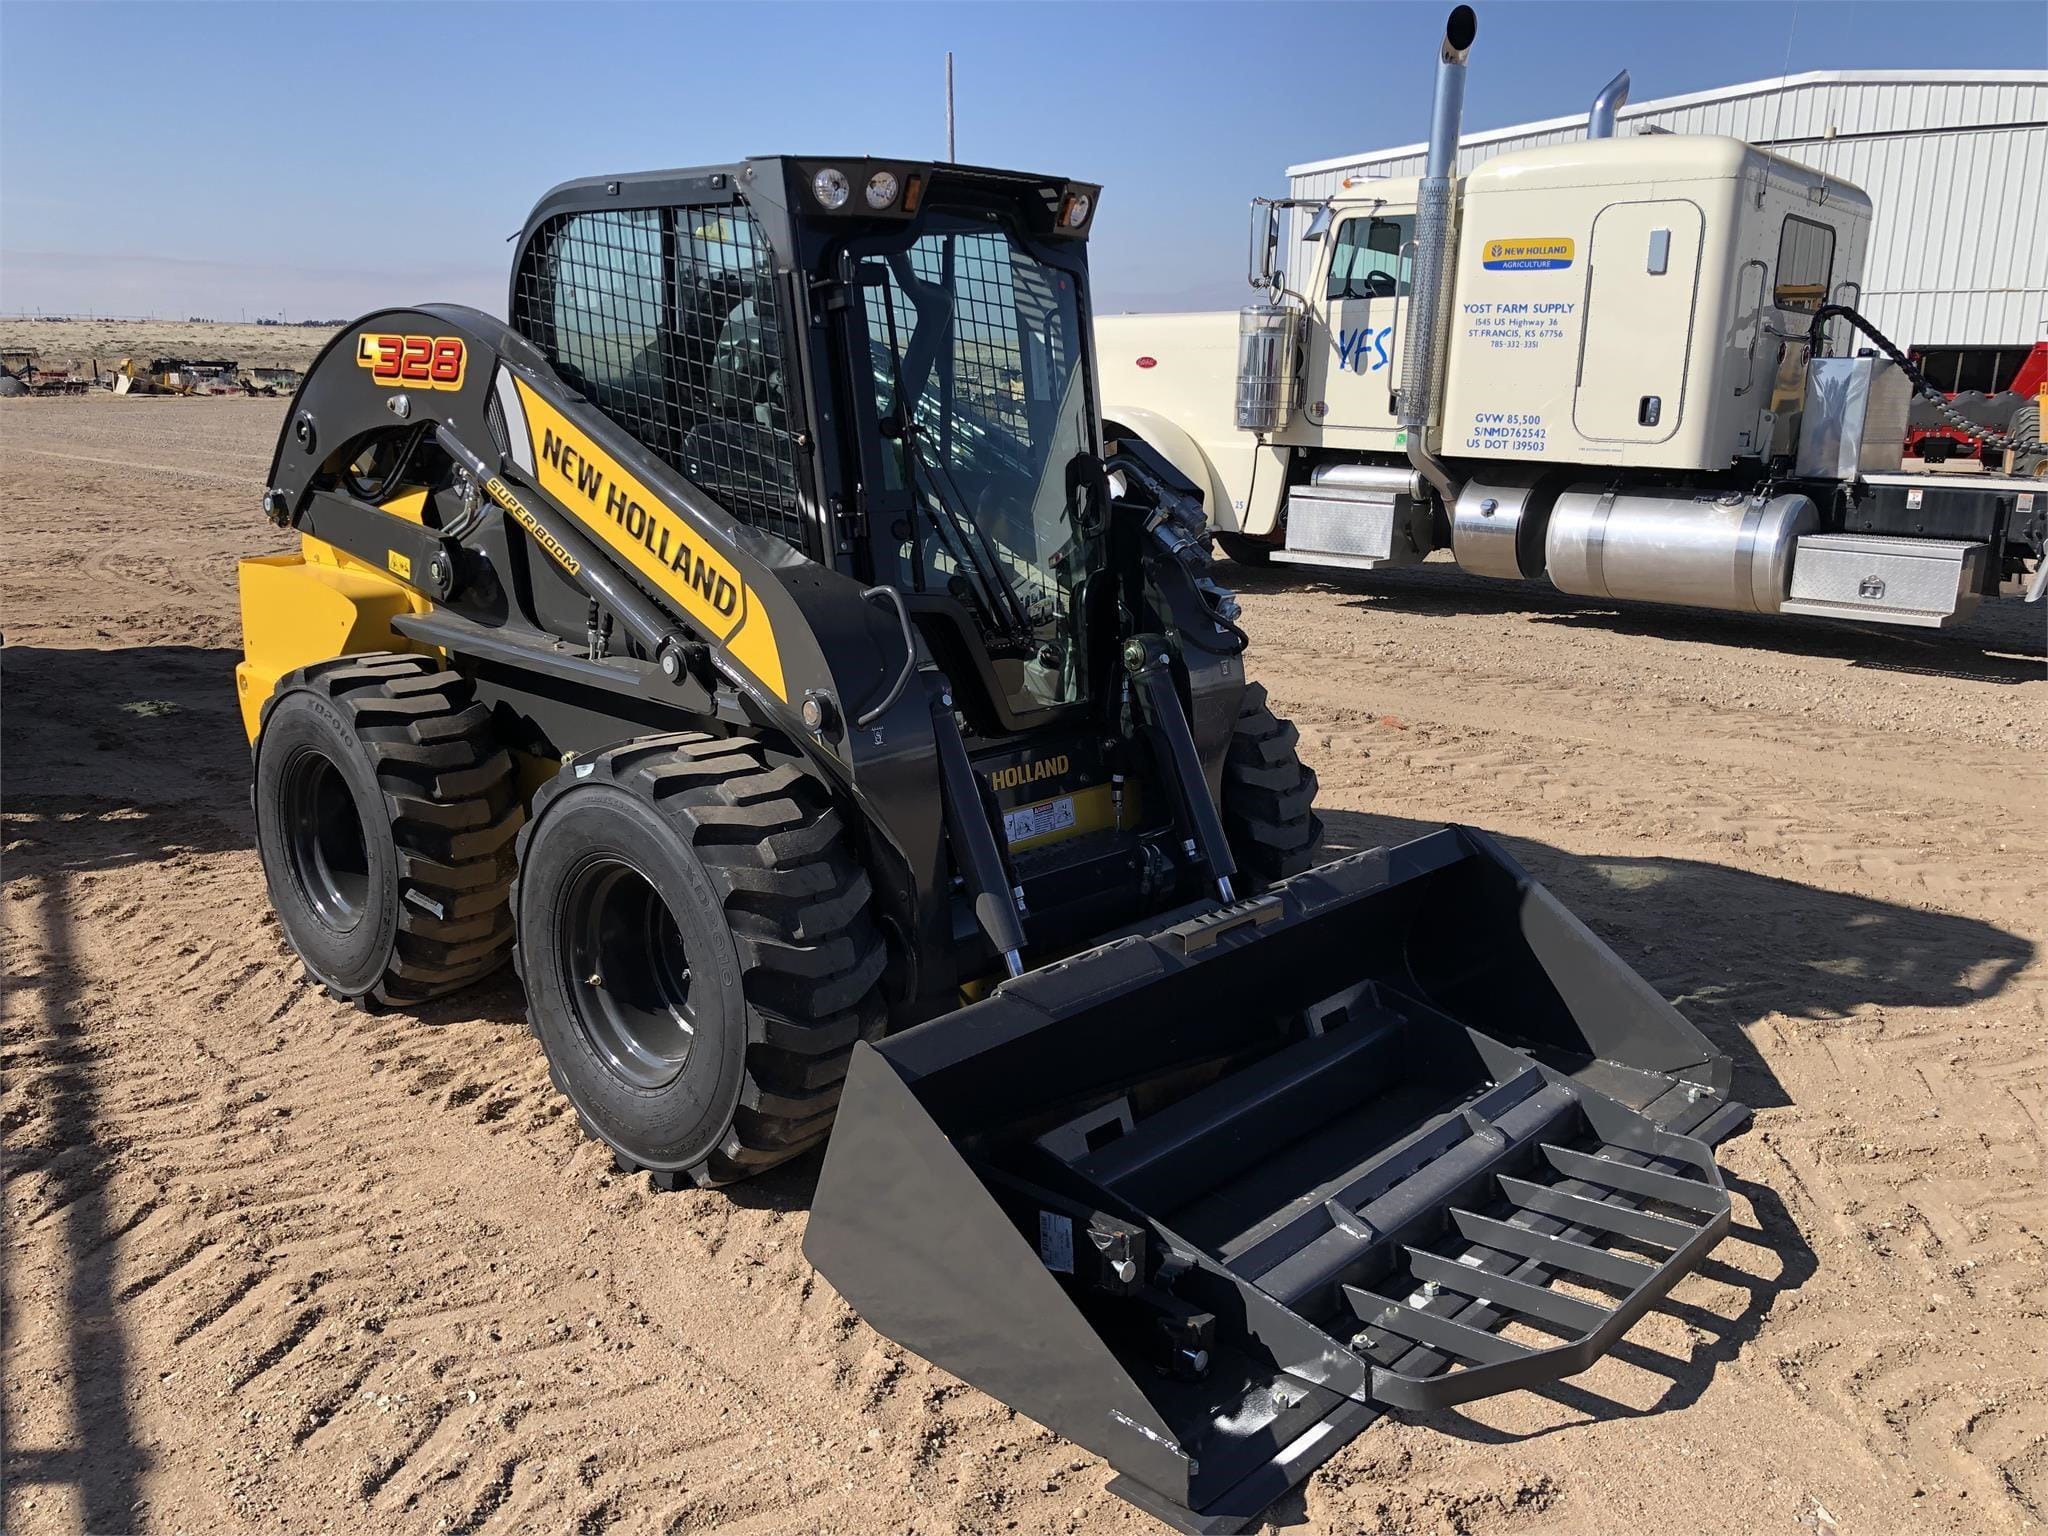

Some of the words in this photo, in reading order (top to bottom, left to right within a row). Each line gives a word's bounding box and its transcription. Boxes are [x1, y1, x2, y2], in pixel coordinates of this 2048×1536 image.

[1504, 246, 1525, 256] NEW
[1526, 245, 1567, 255] HOLLAND
[1502, 261, 1551, 269] AGRICULTURE
[1463, 303, 1492, 314] YOST
[1496, 303, 1528, 314] FARM
[1532, 303, 1575, 314] SUPPLY
[1475, 318, 1491, 327] 1545
[1494, 318, 1506, 326] US
[1508, 318, 1545, 328] Highway
[1548, 318, 1558, 327] 36
[1525, 330, 1536, 338] KS
[1539, 330, 1564, 338] 67756
[1340, 326, 1392, 373] YFS
[1490, 340, 1539, 349] 785-332-3351
[359, 336, 463, 384] L328
[1475, 413, 1504, 424] GVW
[1506, 414, 1541, 426] 85,500
[1466, 439, 1480, 448] US
[1484, 439, 1509, 450] DOT
[1512, 440, 1545, 451] 139503
[487, 479, 536, 528] SUPER
[534, 525, 578, 571] BOOM
[541, 427, 603, 502] NEW
[605, 480, 737, 618] HOLLAND
[991, 754, 1070, 791] HOLLAND
